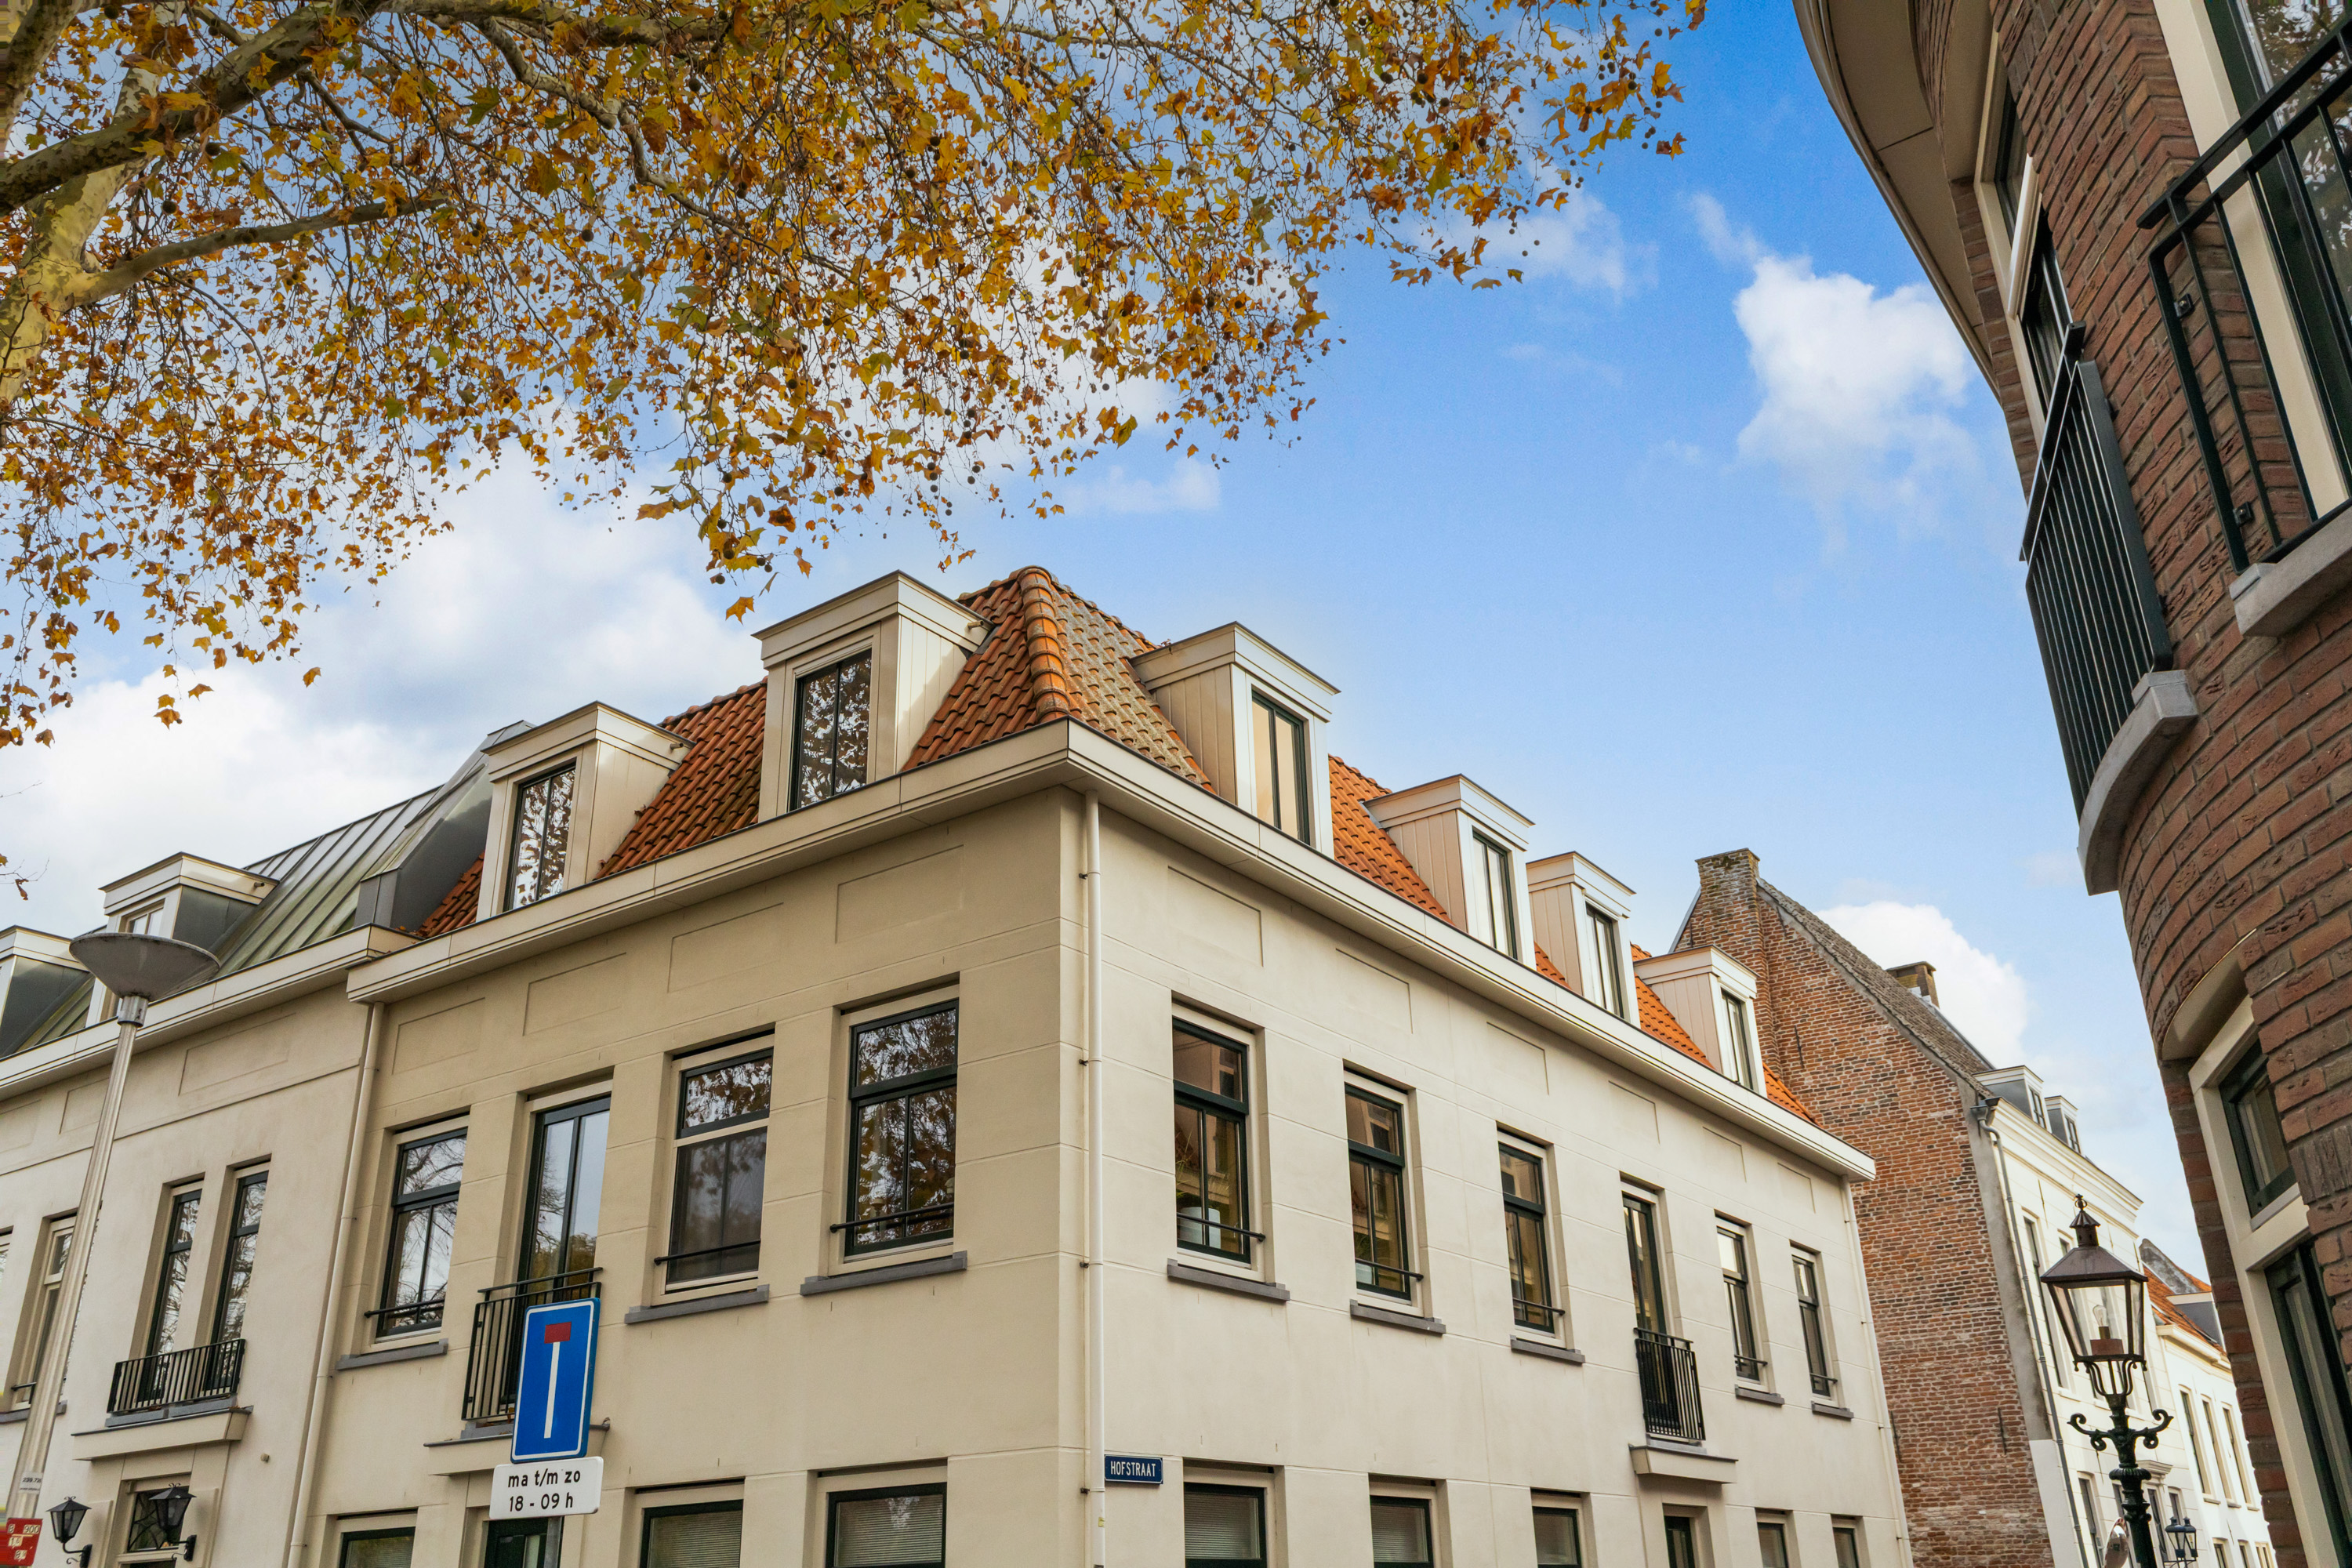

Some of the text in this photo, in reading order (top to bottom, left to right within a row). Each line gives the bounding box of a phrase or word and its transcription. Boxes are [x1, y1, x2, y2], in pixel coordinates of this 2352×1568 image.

[508, 1468, 581, 1488] ma t/m zo
[1110, 1461, 1156, 1477] HOFSTRAAT
[510, 1495, 524, 1512] 18
[541, 1493, 560, 1510] 09
[565, 1492, 573, 1508] h
[24, 1525, 40, 1534] 900
